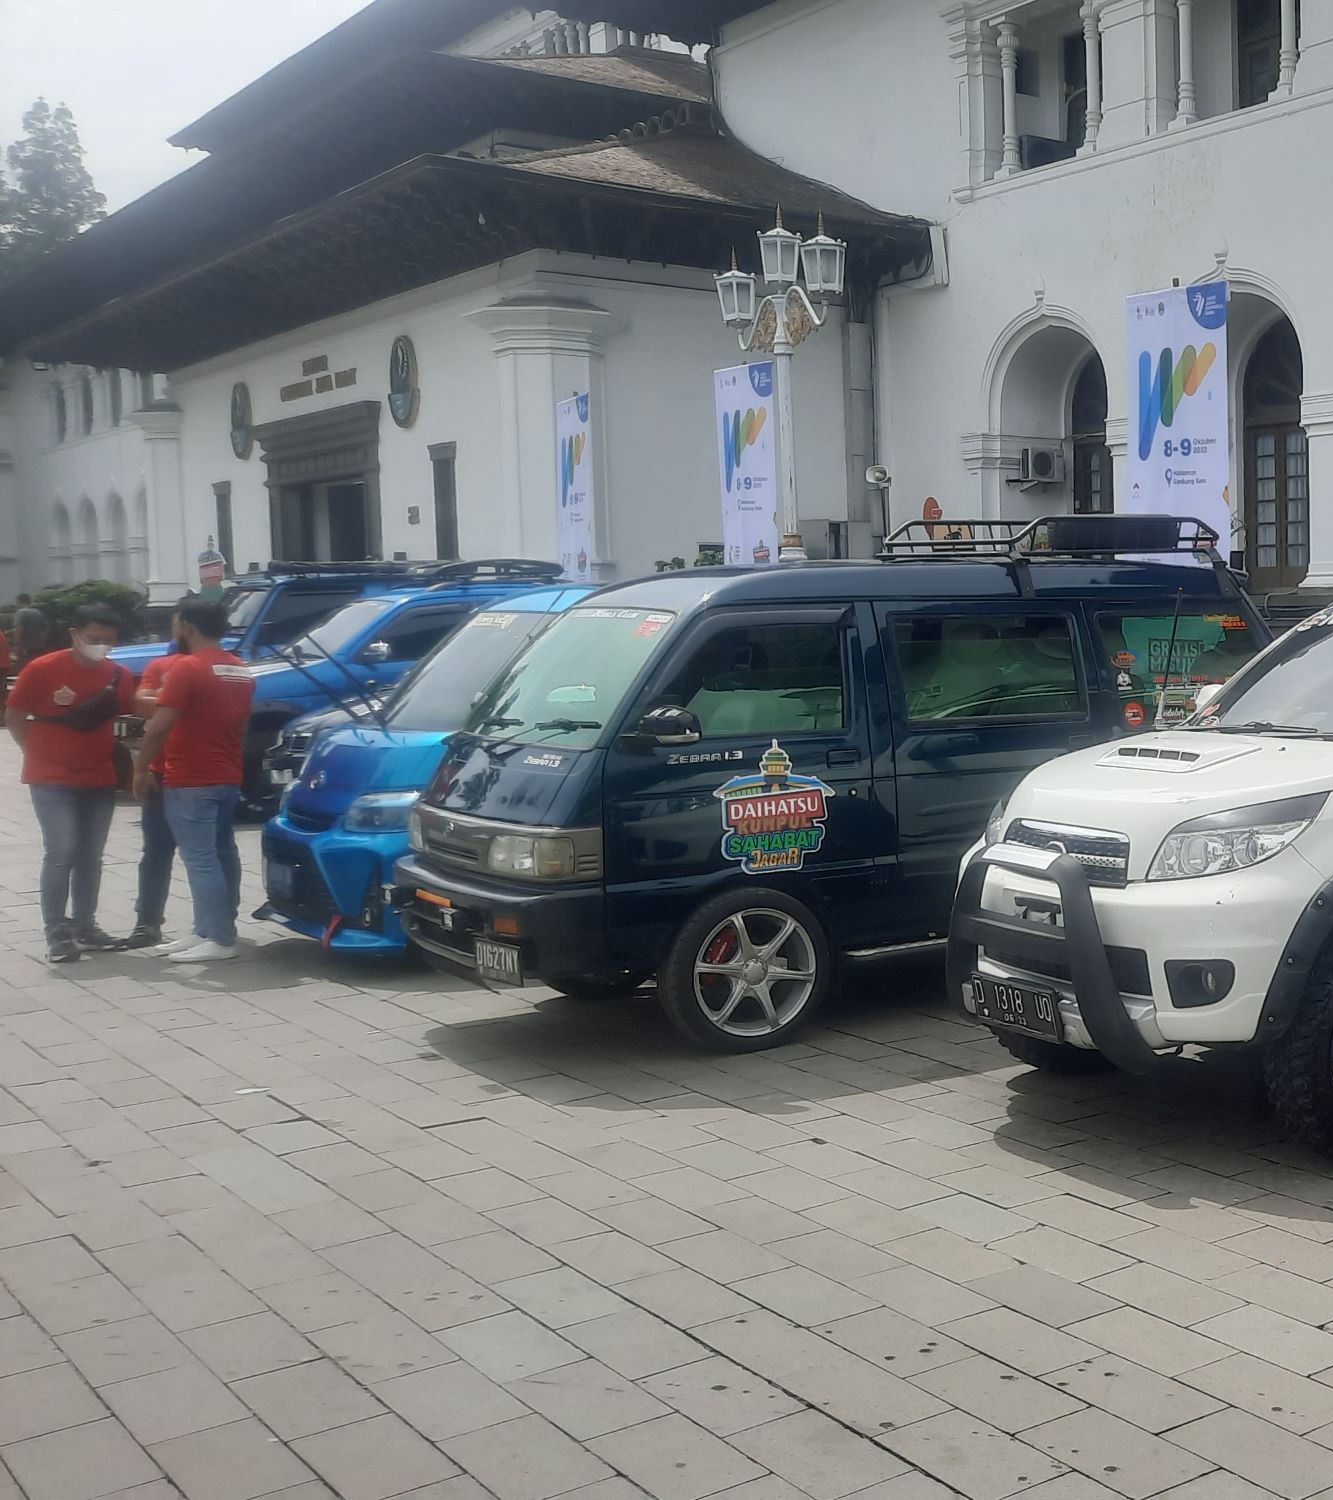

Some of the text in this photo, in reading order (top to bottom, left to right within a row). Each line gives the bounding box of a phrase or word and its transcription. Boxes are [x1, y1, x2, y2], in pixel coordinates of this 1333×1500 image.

[666, 750, 743, 765] ZEBRA 1.3
[730, 796, 818, 820] DAIHATSU
[729, 828, 820, 854] SAHABAT
[751, 847, 800, 869] JABAR
[974, 979, 985, 1003] D
[994, 985, 1024, 1014] 1318
